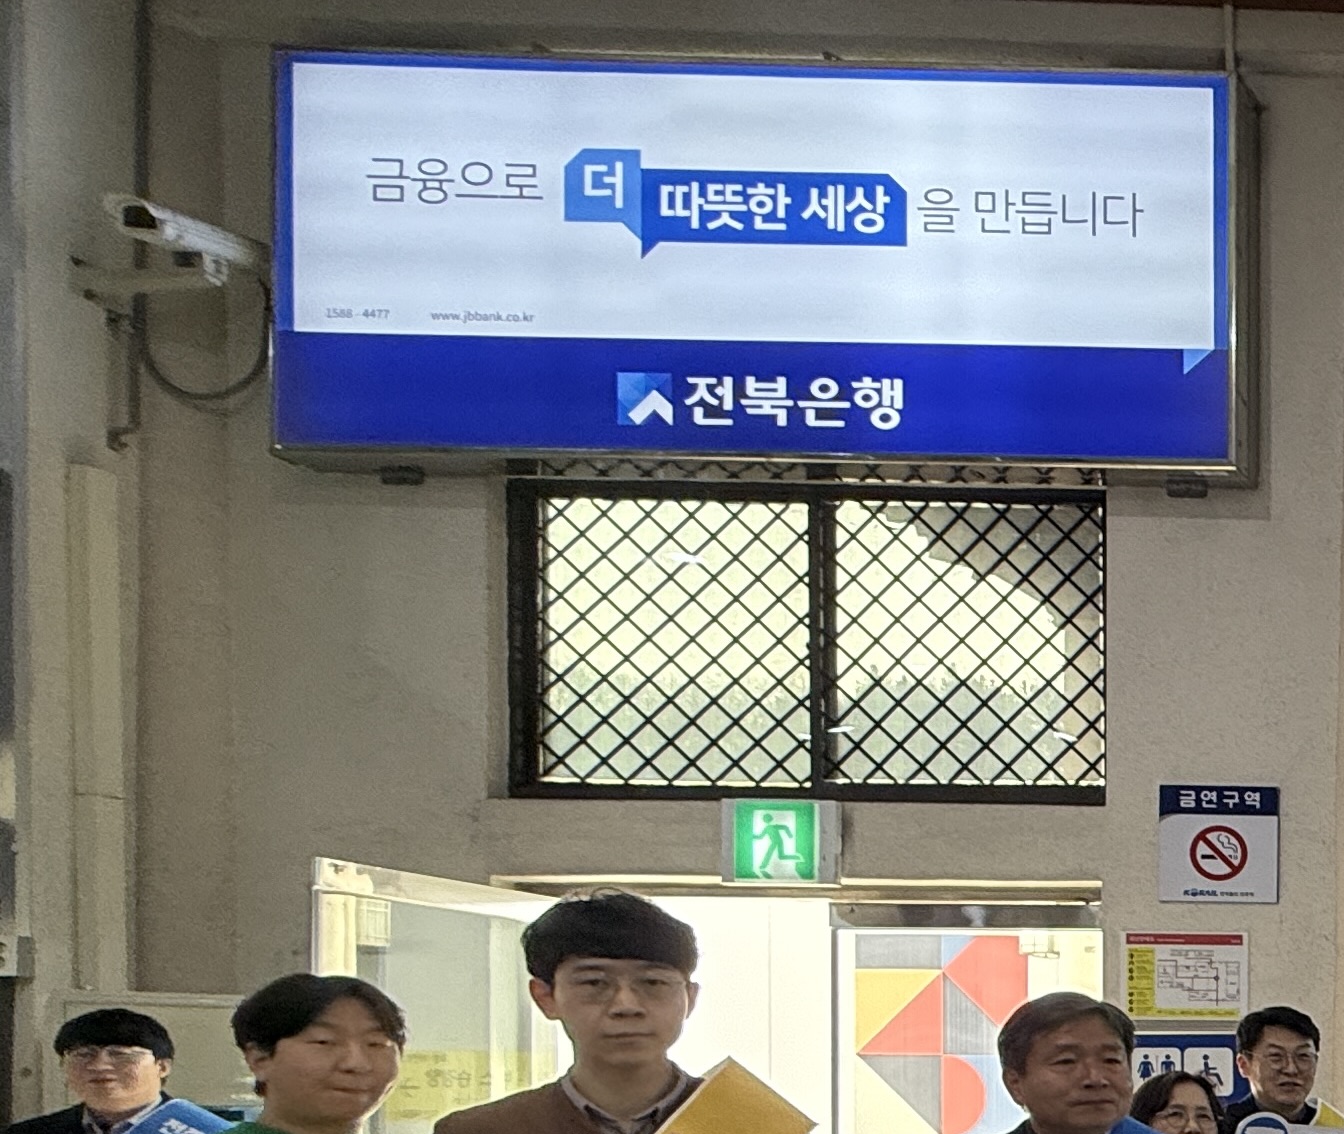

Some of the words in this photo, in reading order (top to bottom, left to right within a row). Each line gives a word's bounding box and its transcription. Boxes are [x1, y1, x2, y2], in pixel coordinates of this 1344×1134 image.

[365, 156, 543, 204] 금융으로
[582, 163, 626, 210] 더
[658, 184, 791, 233] 따뜻한
[801, 184, 891, 236] 세상
[916, 188, 961, 236] 을
[975, 188, 1145, 239] 만듭니다
[430, 310, 535, 324] www.jbbank.co.kr
[683, 376, 905, 431] 전북은행
[1179, 790, 1261, 809] 금연구역
